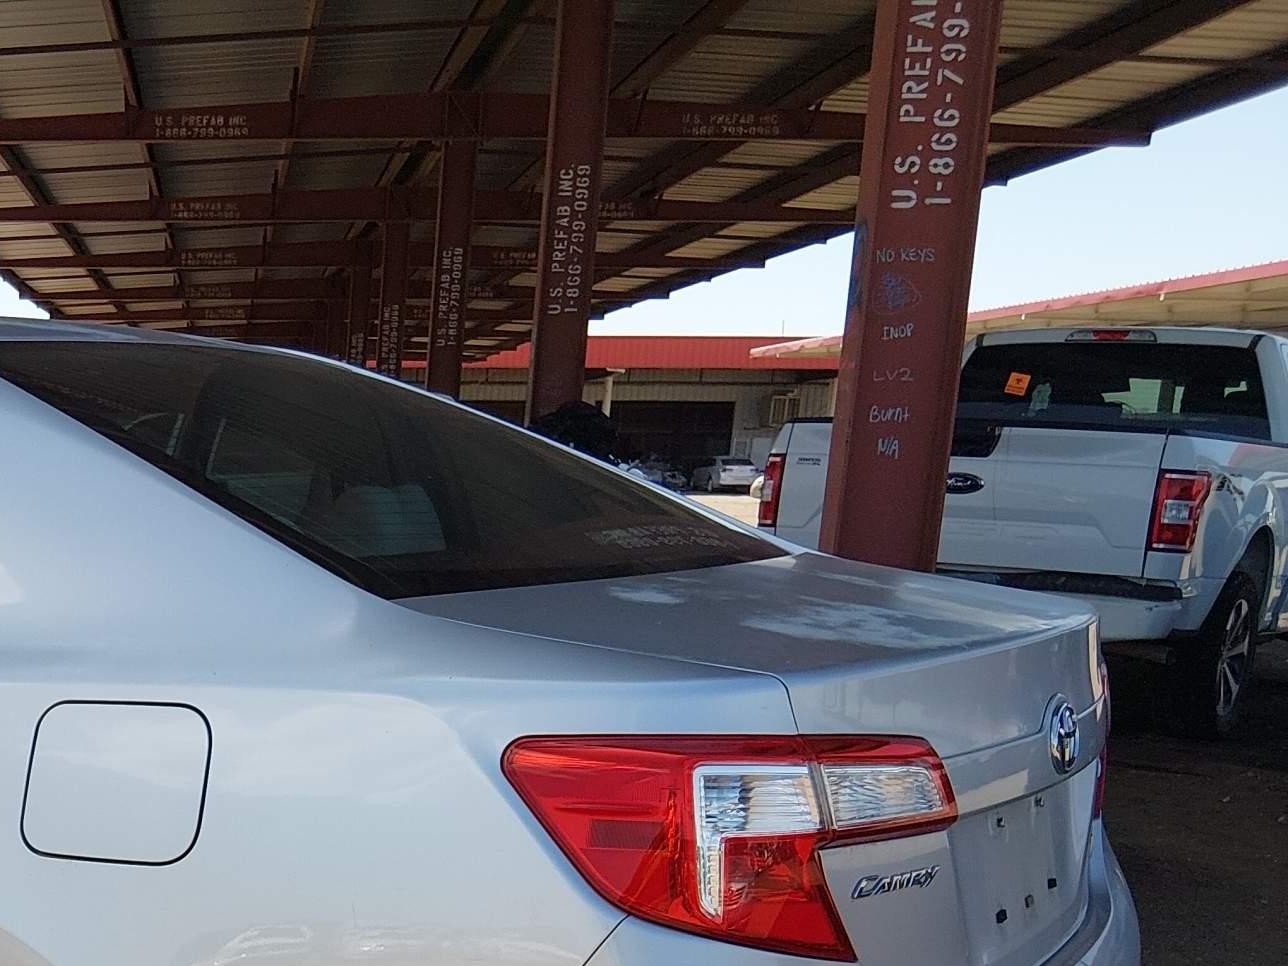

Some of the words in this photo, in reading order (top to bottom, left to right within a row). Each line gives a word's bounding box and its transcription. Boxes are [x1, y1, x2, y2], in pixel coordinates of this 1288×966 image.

[899, 0, 938, 122] PREFA
[558, 163, 575, 196] INC.
[890, 144, 923, 209] U.S.
[551, 205, 571, 272] PREFAB
[564, 164, 591, 313] 1-866-799-0969
[876, 247, 895, 264] NO
[900, 247, 936, 263] KEYS
[547, 282, 564, 315] U.S.
[880, 322, 914, 340] INOP
[872, 367, 914, 381] LV2
[869, 404, 910, 423] Burnt
[877, 436, 899, 460] N/A
[851, 864, 942, 900] CAMRY
